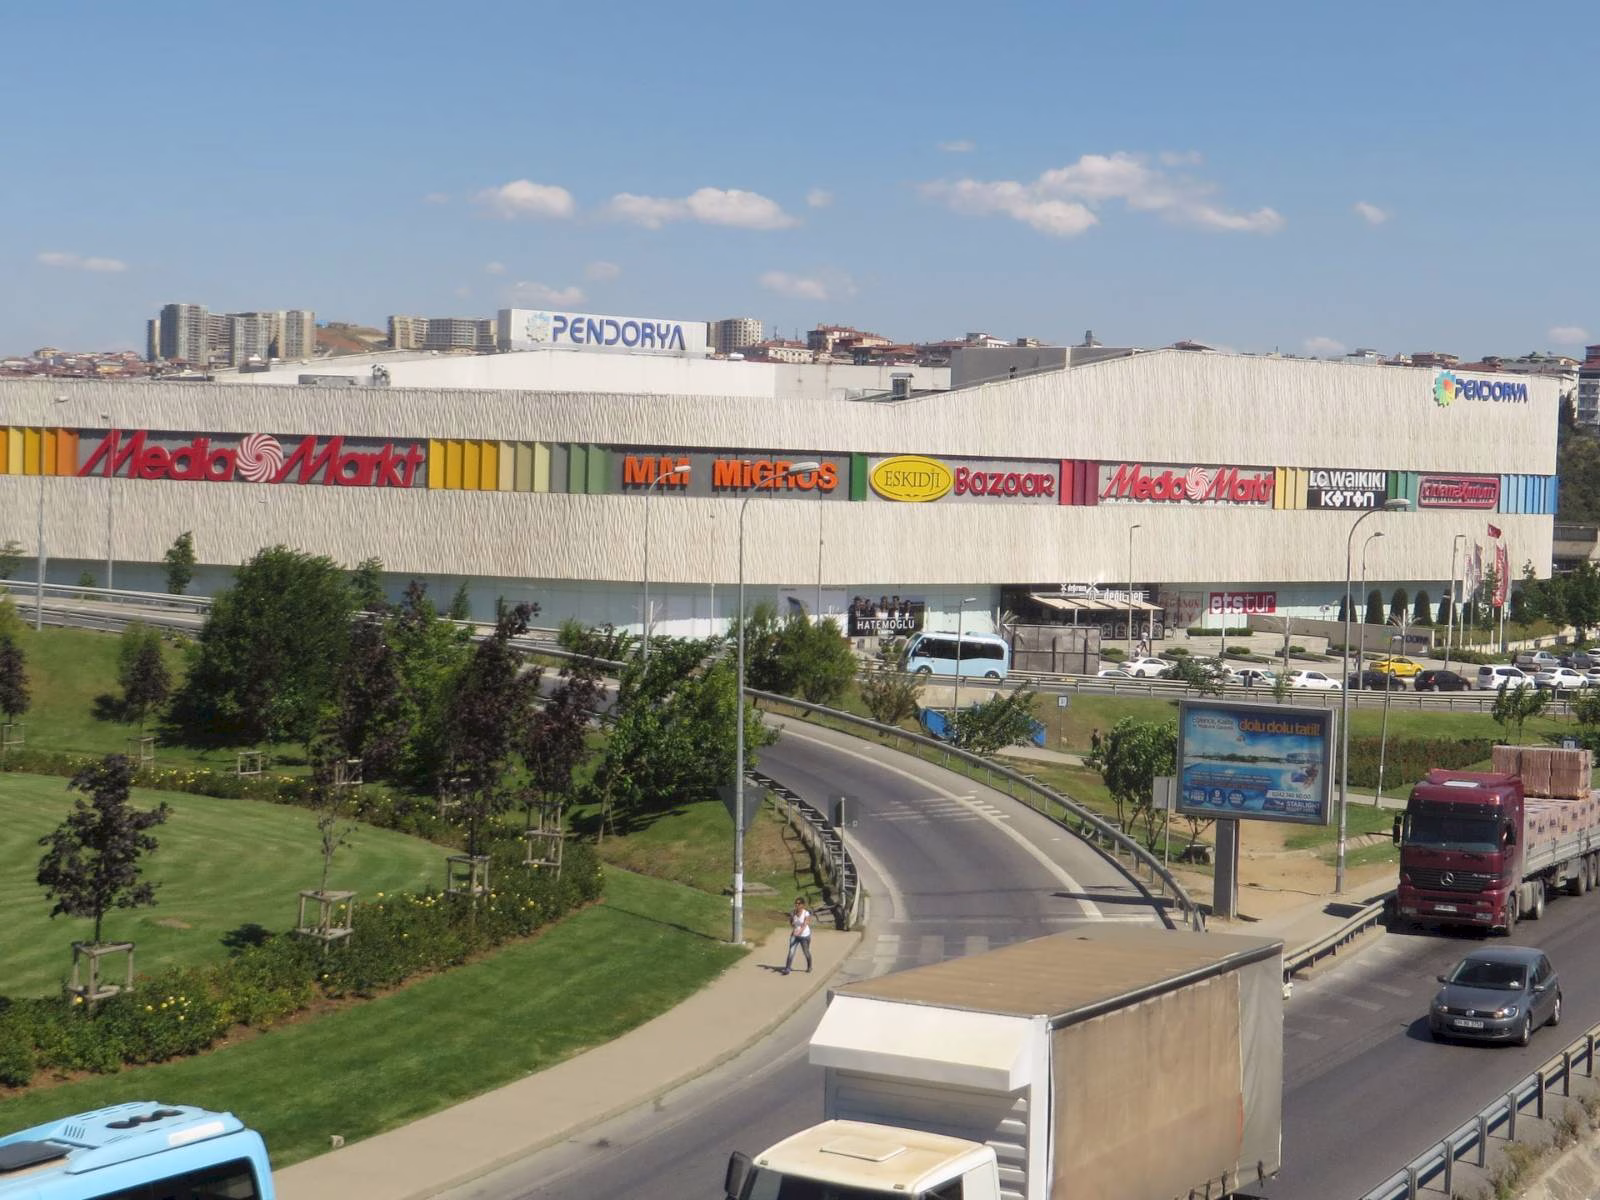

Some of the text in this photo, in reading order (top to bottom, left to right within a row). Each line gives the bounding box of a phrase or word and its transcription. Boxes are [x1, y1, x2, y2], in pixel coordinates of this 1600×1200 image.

[553, 315, 686, 350] PENDORYA
[1455, 378, 1528, 404] PENDORYA
[79, 429, 424, 487] Media Markt
[624, 455, 690, 487] MM
[1103, 463, 1188, 501] Media
